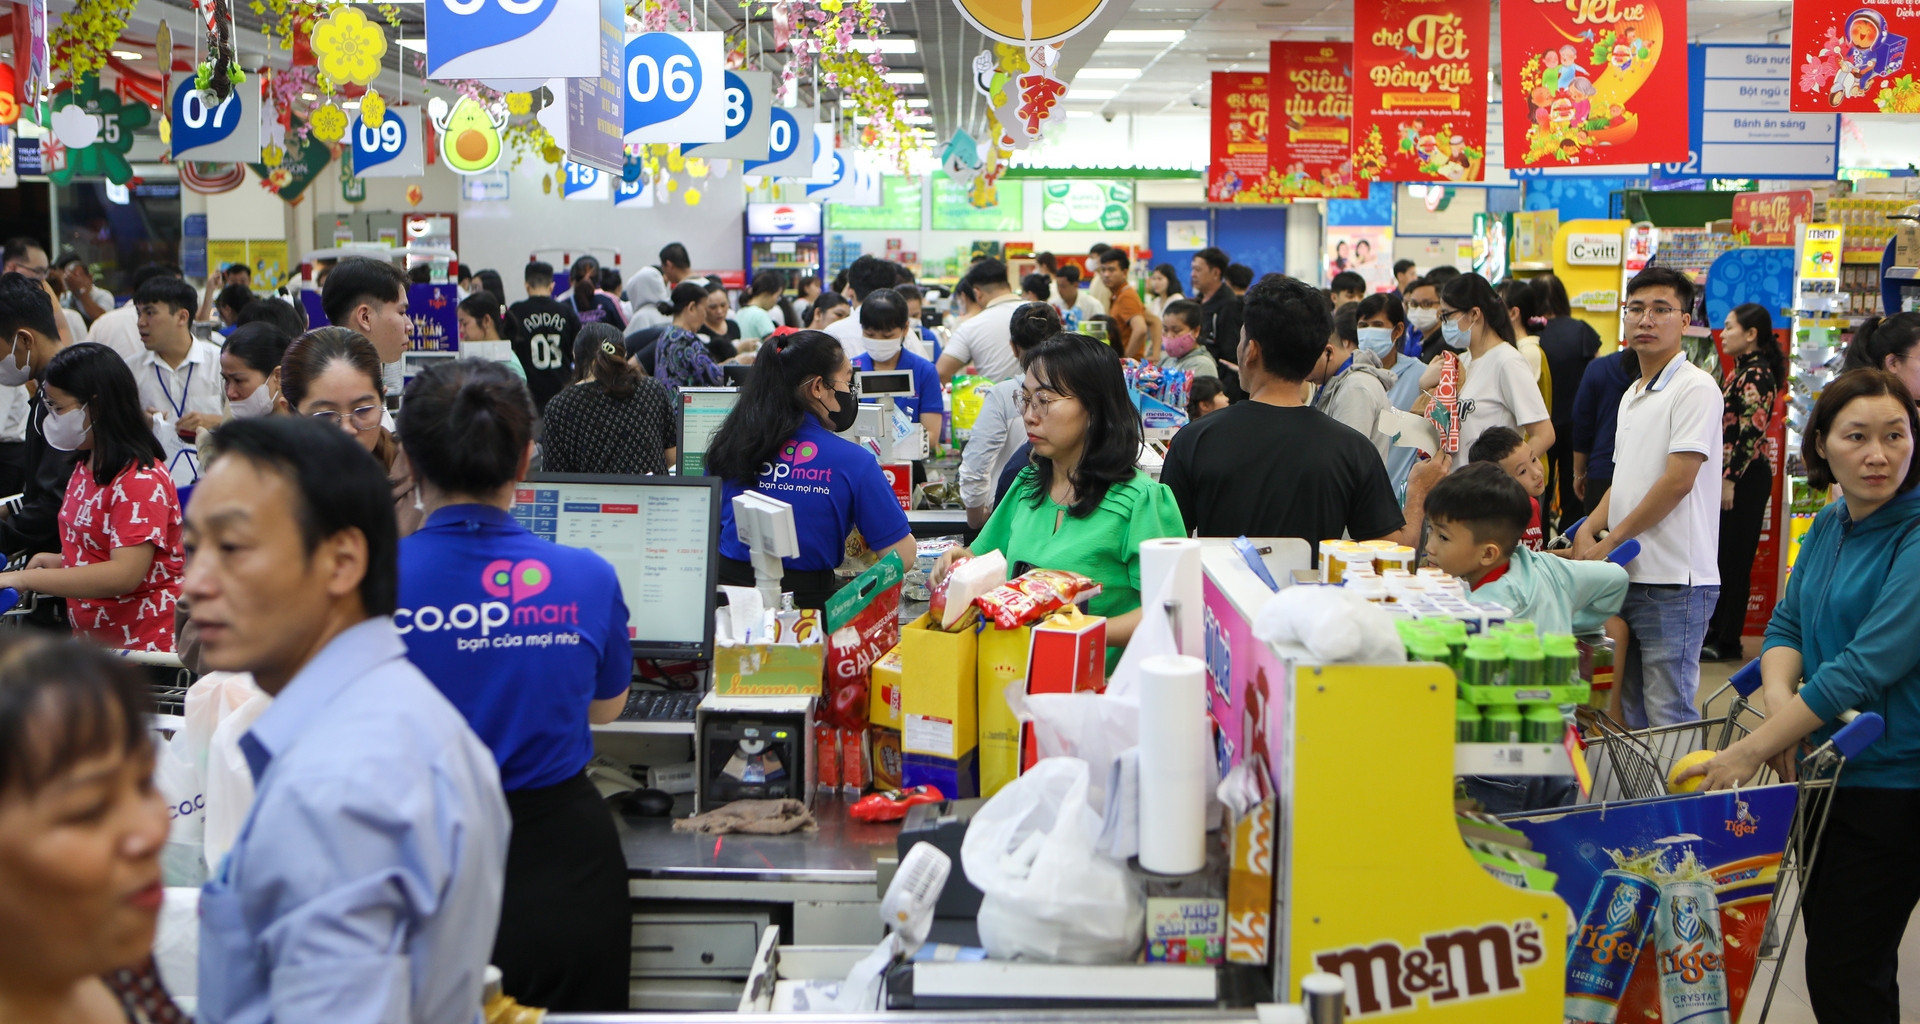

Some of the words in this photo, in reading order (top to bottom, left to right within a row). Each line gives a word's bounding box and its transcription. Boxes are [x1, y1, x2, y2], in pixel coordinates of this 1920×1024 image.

[1371, 27, 1404, 51] chợ
[1406, 12, 1470, 60] Tết
[626, 54, 695, 103] 06
[1289, 69, 1348, 93] Siêu
[1370, 61, 1432, 93] Đồng
[1430, 62, 1473, 93] Giá
[1739, 86, 1758, 98] Bột
[182, 89, 229, 130] 07
[1734, 118, 1761, 129] Bánh
[359, 119, 402, 153] 09
[1573, 243, 1616, 258] C-vitt
[523, 312, 567, 334] ADIDAS
[530, 333, 563, 371] 03
[758, 480, 777, 491] bạn
[777, 482, 794, 491] của
[795, 485, 812, 494] mọi
[812, 486, 831, 495] nhà
[457, 637, 490, 653] bạn
[492, 632, 524, 648] của
[525, 631, 554, 650] mọi
[554, 630, 581, 646] nhà
[836, 641, 883, 678] GALA
[1725, 819, 1758, 838] Tiger
[1571, 969, 1595, 983] LAGER
[1595, 977, 1615, 990] BEER
[1672, 992, 1719, 1004] CRYSTAL
